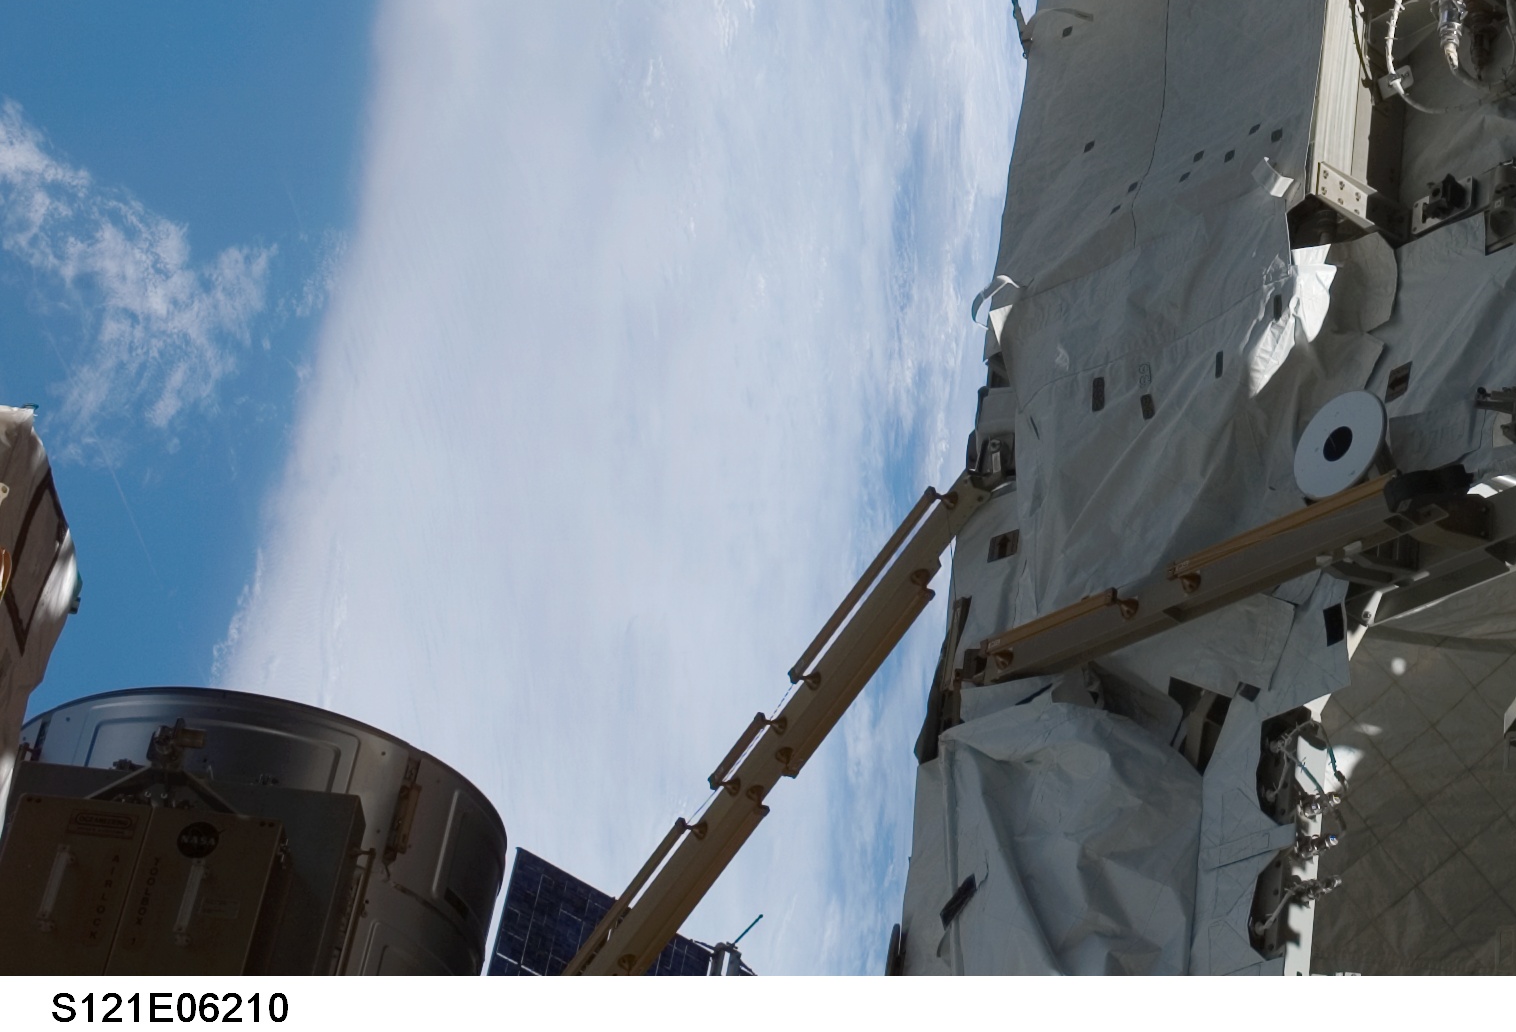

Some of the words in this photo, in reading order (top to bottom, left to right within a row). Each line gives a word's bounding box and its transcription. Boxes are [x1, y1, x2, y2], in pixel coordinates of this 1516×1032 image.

[180, 834, 216, 847] NASA
[89, 854, 120, 939] AIRLOCK
[135, 857, 161, 926] TOOLBOX
